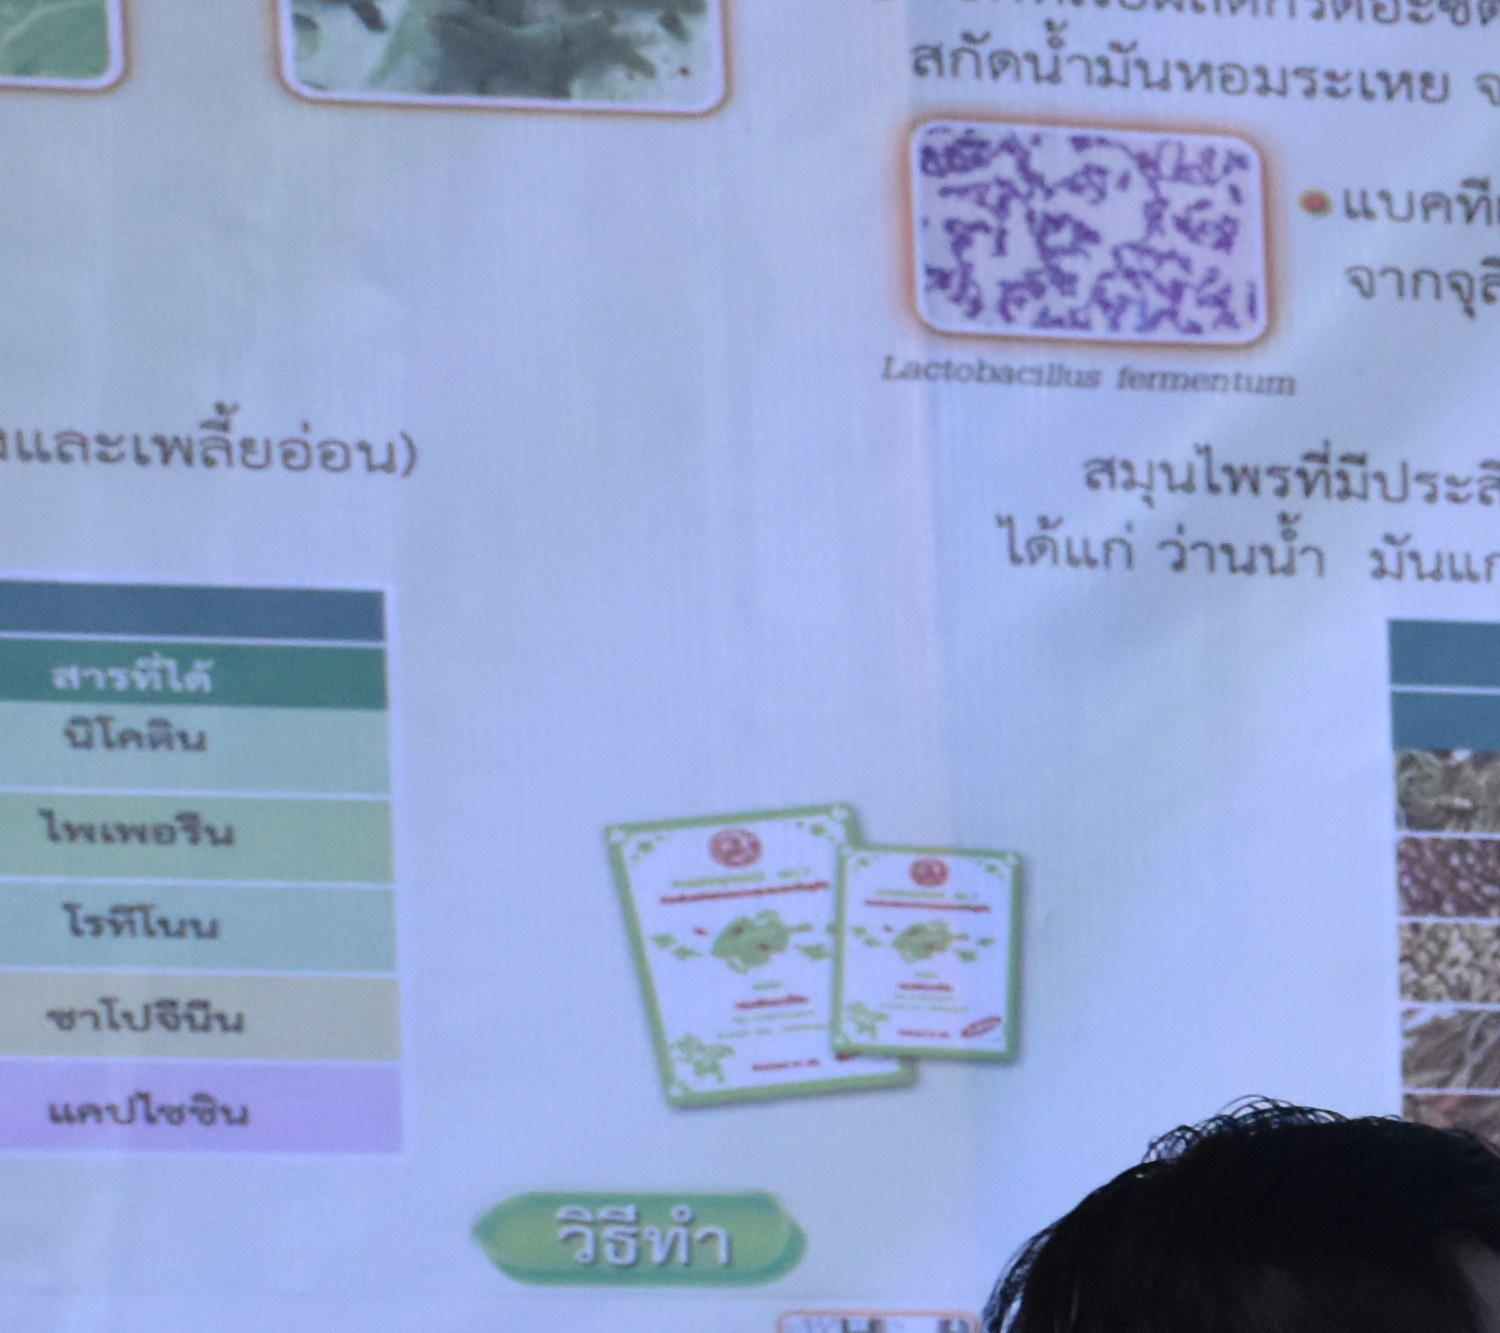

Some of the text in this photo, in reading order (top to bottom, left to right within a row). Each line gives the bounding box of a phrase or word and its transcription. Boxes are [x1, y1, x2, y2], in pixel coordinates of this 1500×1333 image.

[912, 17, 1451, 105] สกัดน้ำมันหอมระเหย
[880, 353, 1298, 398] Lactobacillus fermentum
[996, 513, 1135, 571] ได้แก่
[1157, 511, 1326, 578] ว่านน้ำ
[555, 1203, 738, 1270] วิธีทำ
